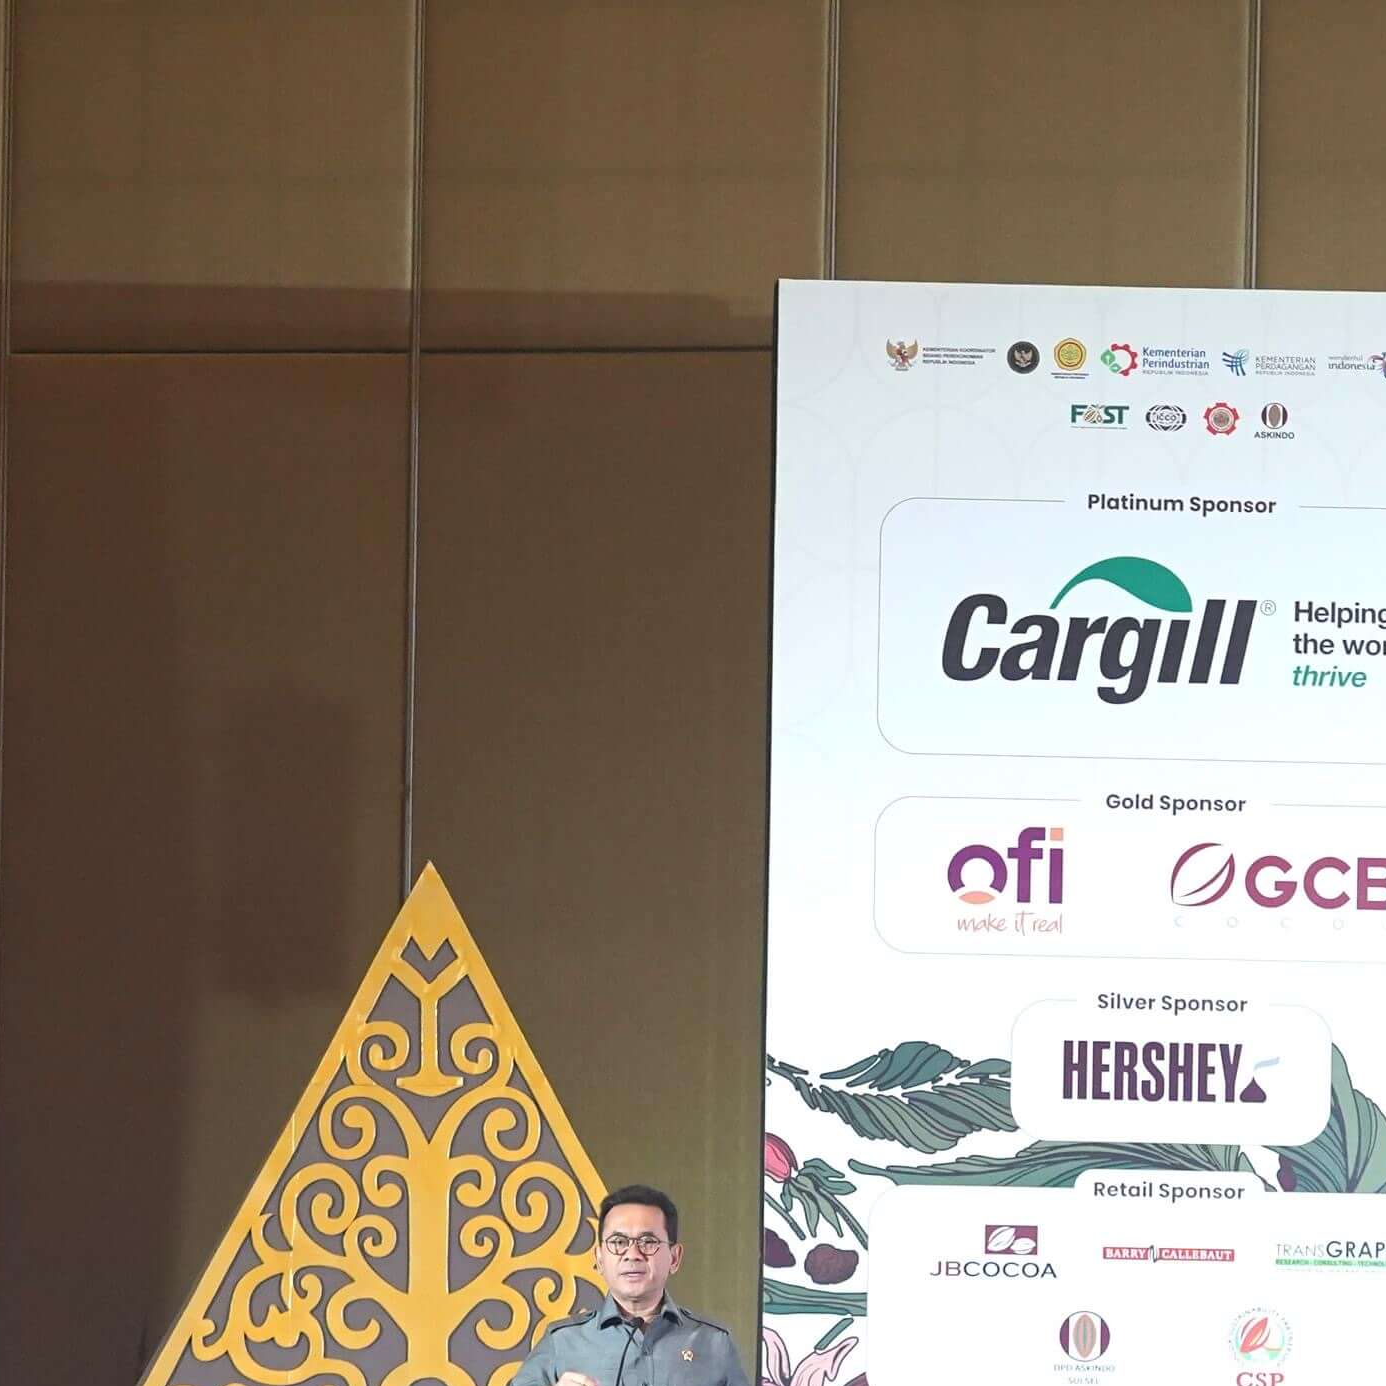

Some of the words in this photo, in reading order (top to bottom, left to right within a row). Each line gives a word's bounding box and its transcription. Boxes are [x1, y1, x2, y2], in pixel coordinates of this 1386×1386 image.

[1143, 347, 1206, 358] Kementerian
[1256, 356, 1316, 364] KEMENTERIAN
[1143, 358, 1210, 370] Perindustrian
[1256, 363, 1316, 371] PERDAGANGAN
[1254, 431, 1295, 439] ASKINDO
[1088, 494, 1183, 511] Platinum
[1190, 497, 1276, 517] Sponsor
[941, 593, 1257, 704] Cargill
[1293, 633, 1334, 654] the
[1293, 665, 1366, 687] thrive
[1106, 794, 1153, 809] Gold
[1160, 795, 1246, 816] Sponsor
[948, 827, 1063, 904] ofi
[957, 913, 1008, 932] make
[1032, 913, 1063, 934] real
[1098, 993, 1156, 1009] Silver
[1162, 996, 1247, 1016] Sponsor
[1062, 1040, 1243, 1103] HERSHEY
[1094, 1181, 1154, 1197] Retail
[1159, 1184, 1245, 1203] Sponsor
[1105, 1248, 1145, 1258] BARRY
[1161, 1248, 1232, 1260] CALLEBAUT
